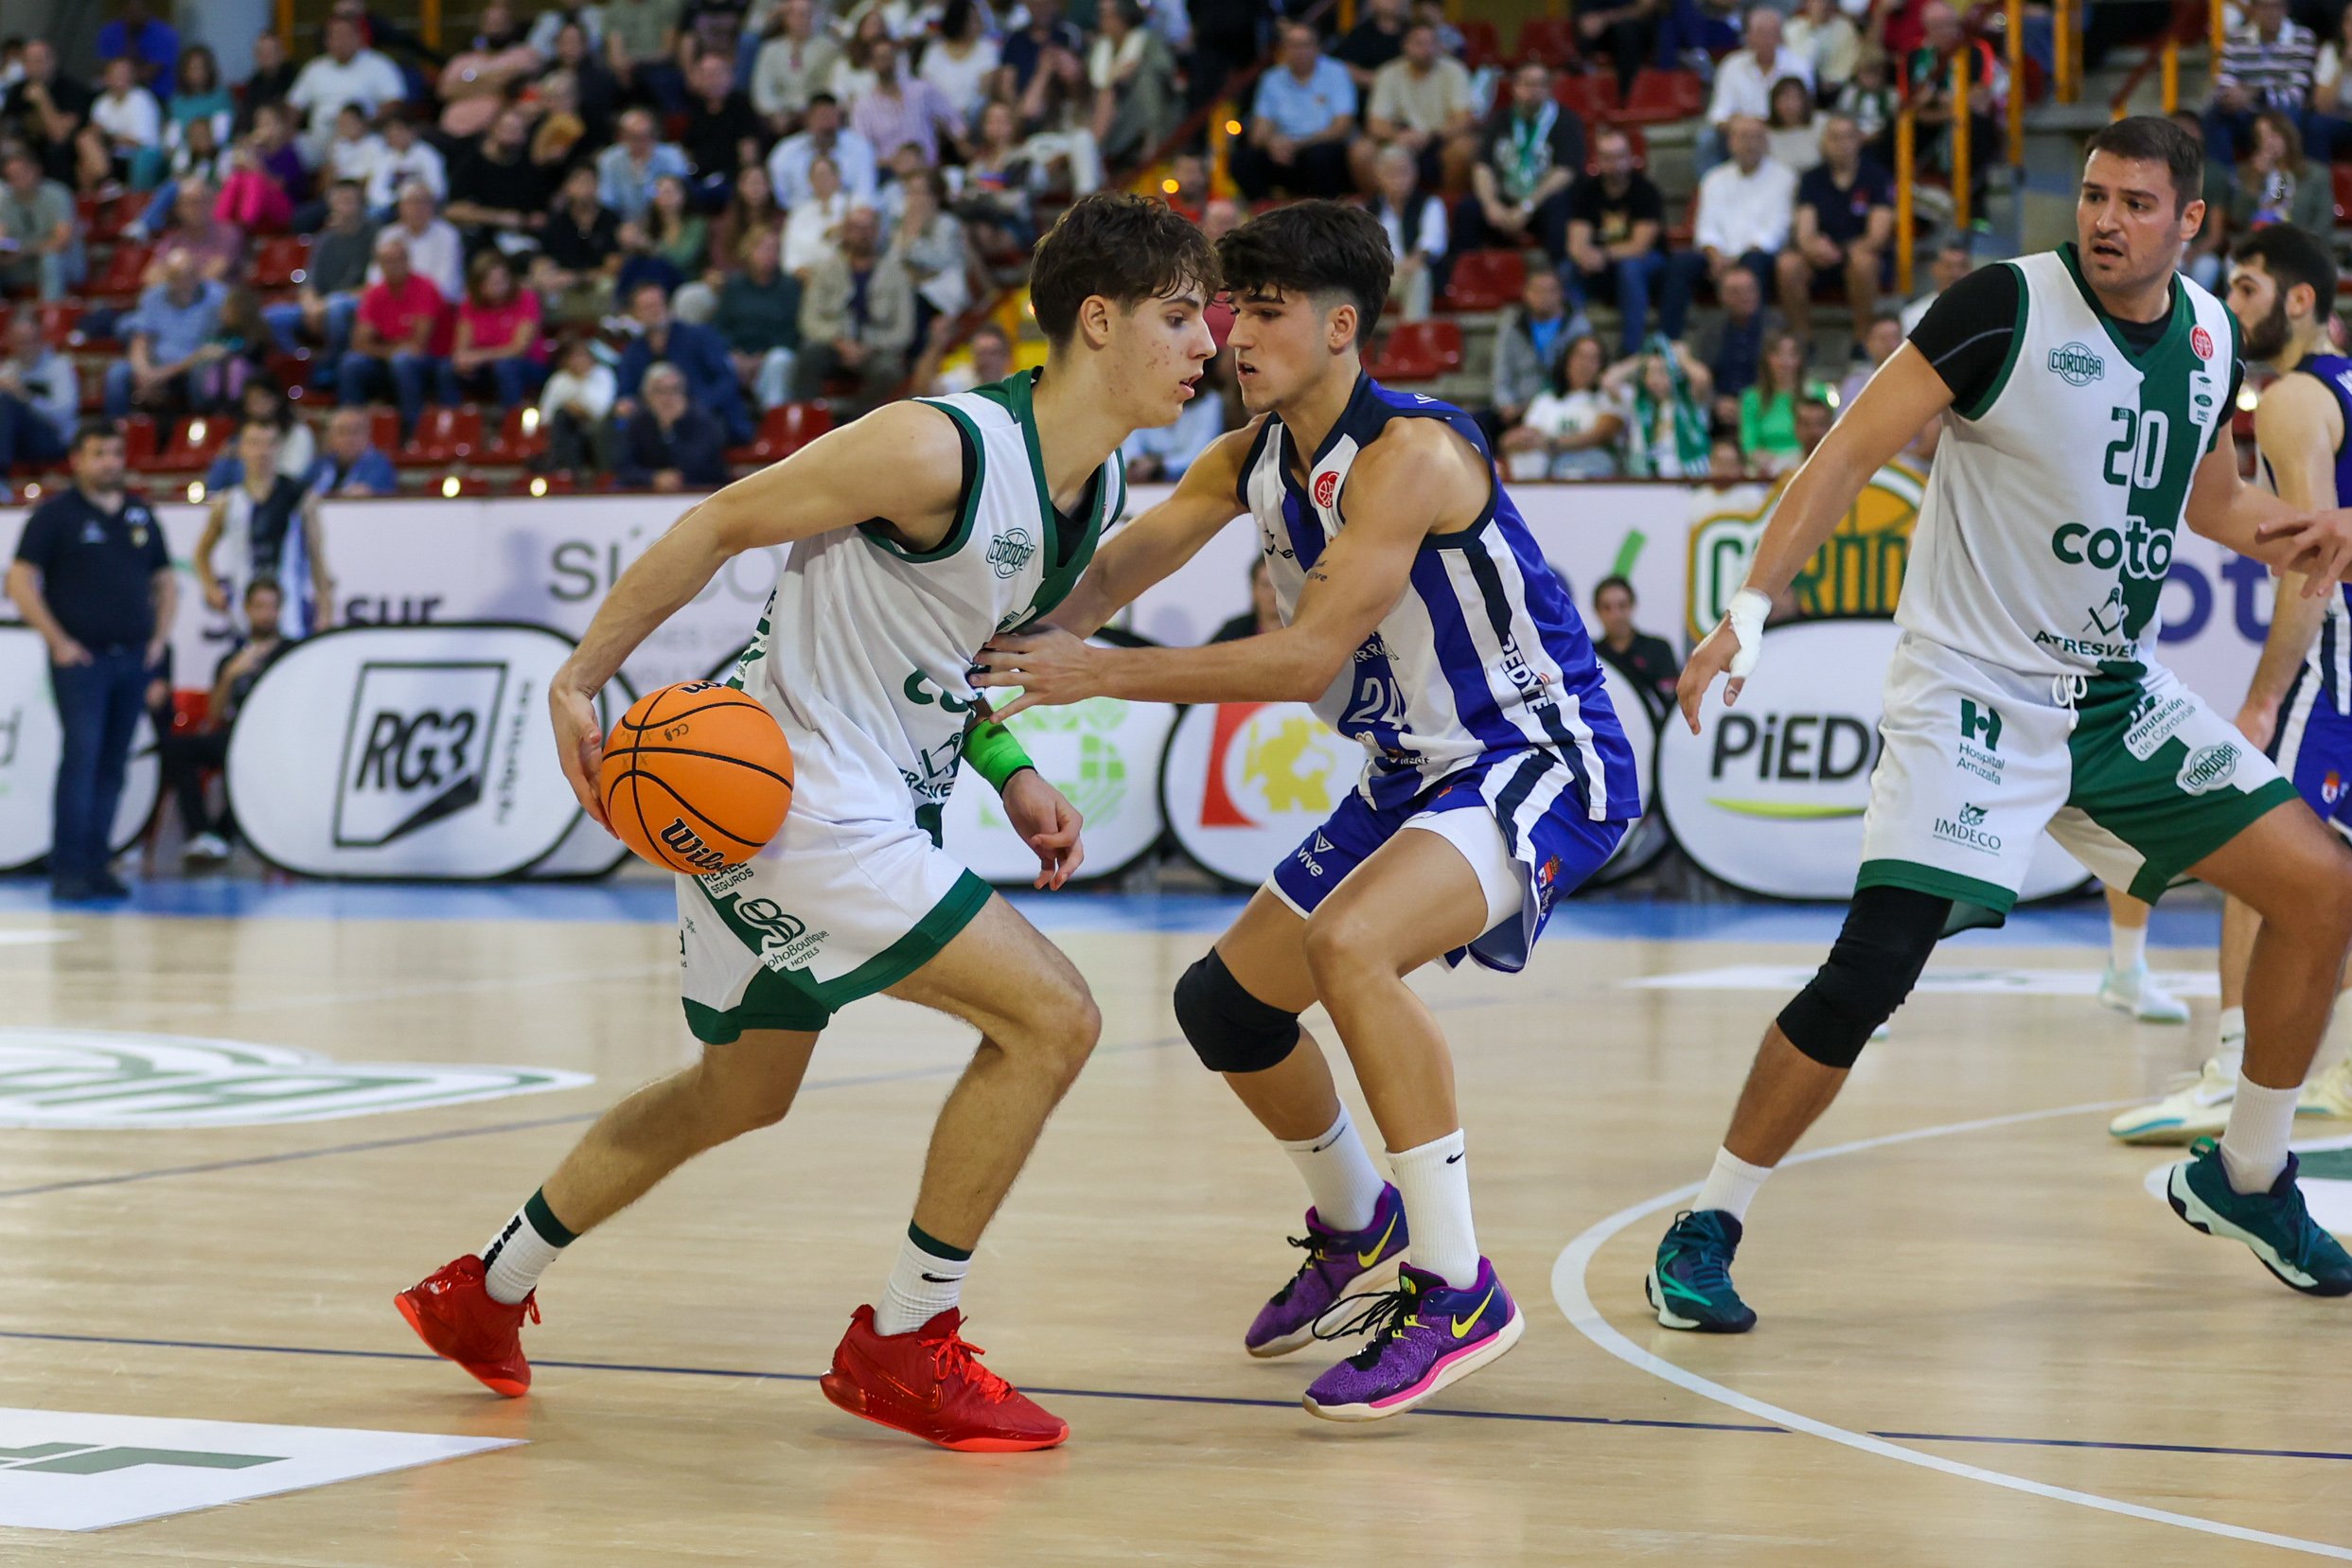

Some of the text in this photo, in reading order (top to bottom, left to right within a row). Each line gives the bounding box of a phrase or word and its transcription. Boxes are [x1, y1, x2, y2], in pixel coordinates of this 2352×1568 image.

[2103, 406, 2170, 490] 20
[2051, 520, 2173, 577] coto
[1347, 677, 1406, 731] 24
[2128, 696, 2185, 746] Diputación
[355, 710, 477, 793] RG3
[1711, 714, 1883, 781] PiED
[1958, 742, 2006, 770] Hospital
[2136, 740, 2155, 756] de
[1956, 757, 2002, 786] Arruzafa
[1934, 818, 2002, 851] IMDECO
[1297, 847, 1324, 878] vive
[710, 868, 755, 894] SEGUROS
[765, 929, 830, 969] ohoBoutique
[790, 946, 821, 967] HOTELS
